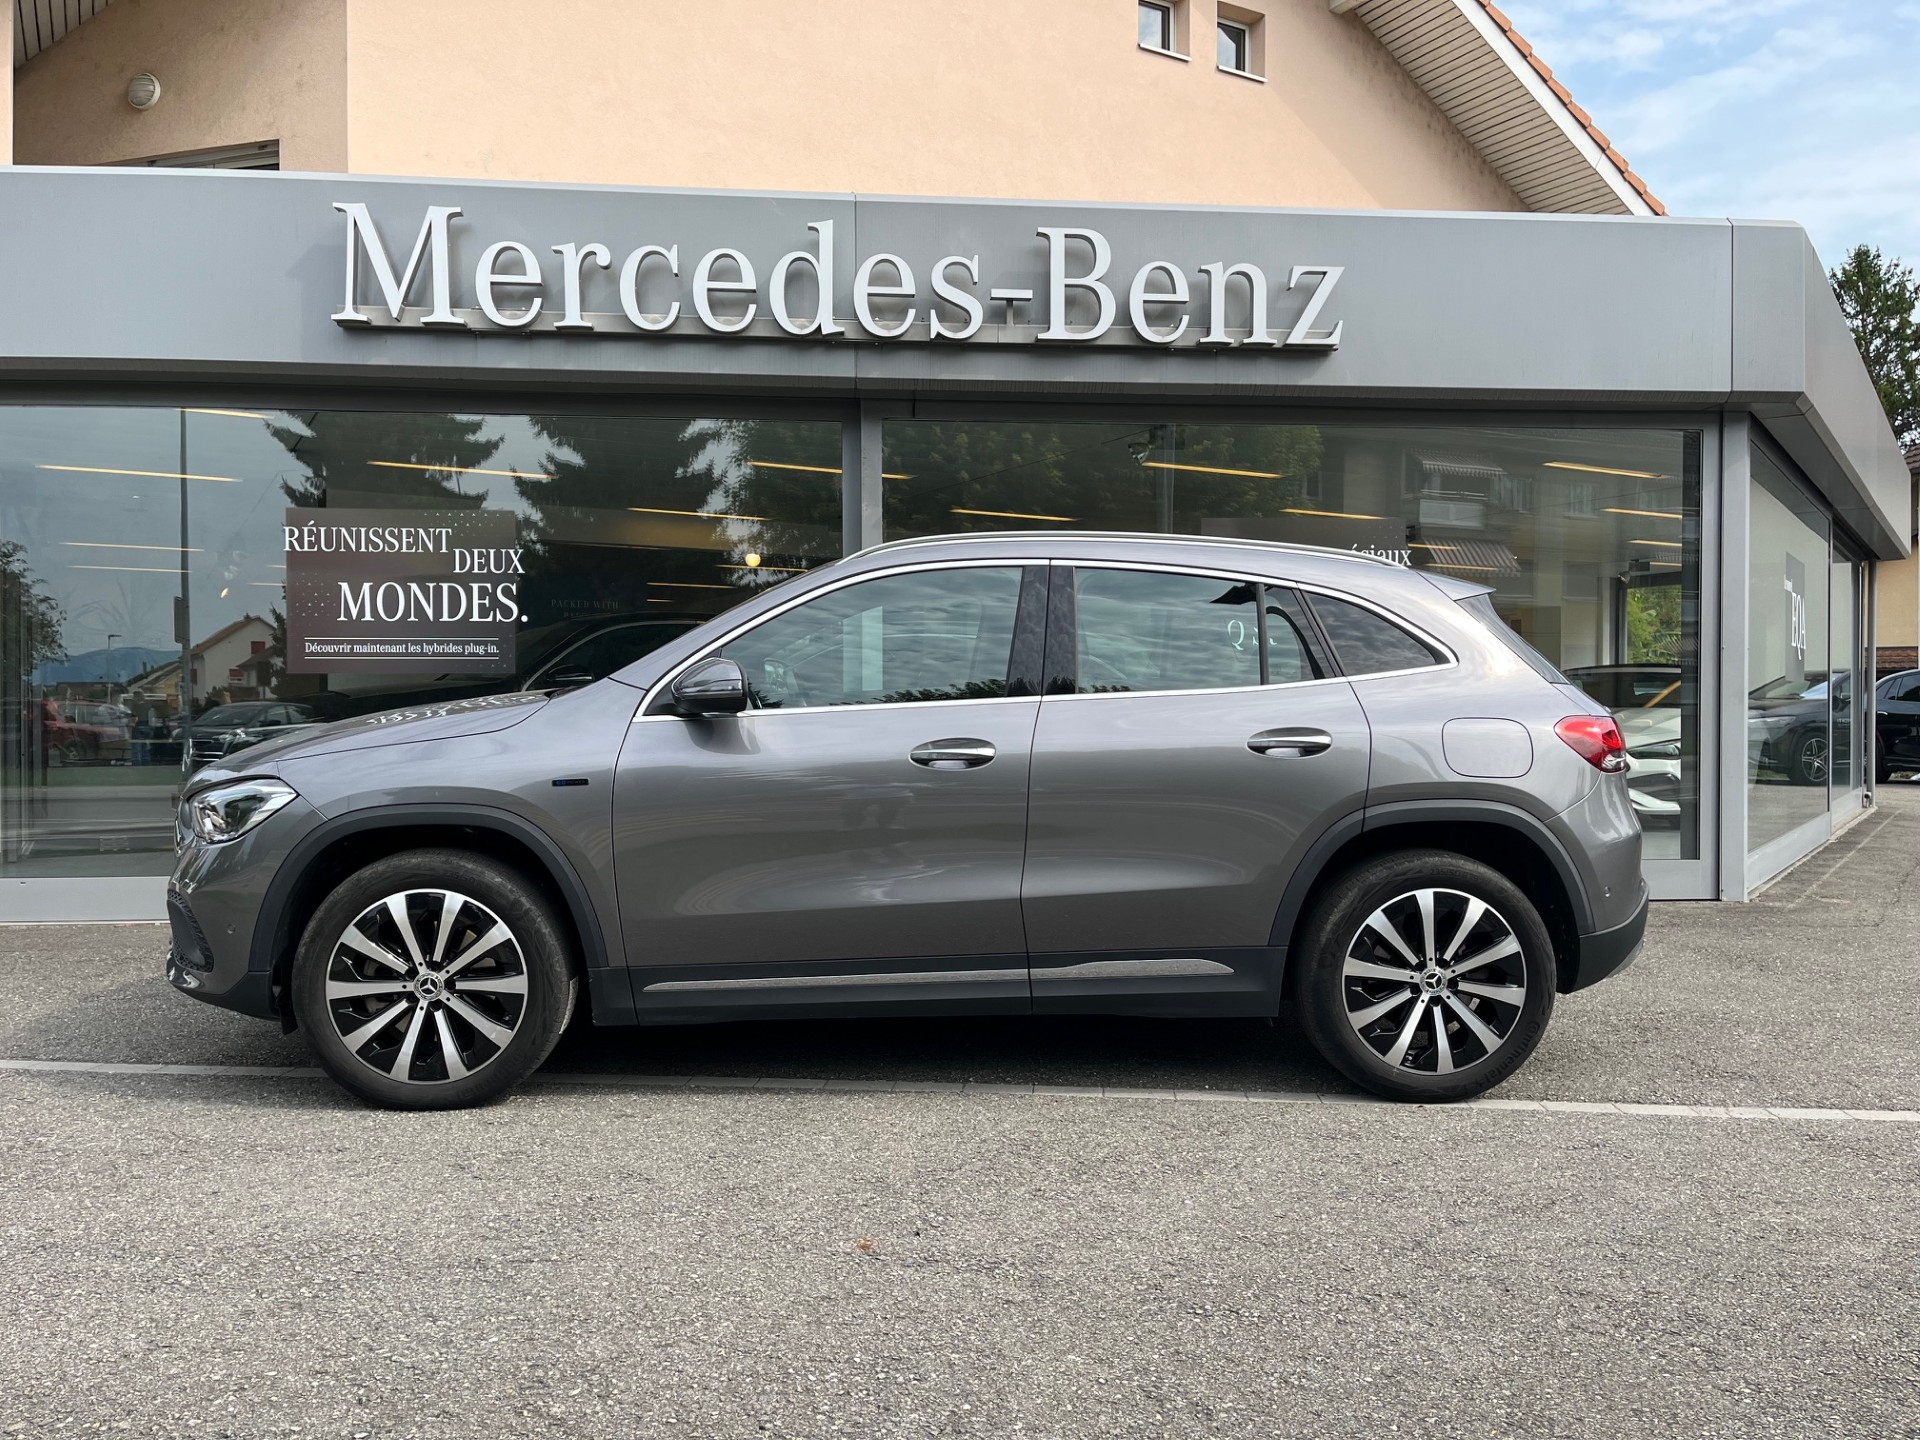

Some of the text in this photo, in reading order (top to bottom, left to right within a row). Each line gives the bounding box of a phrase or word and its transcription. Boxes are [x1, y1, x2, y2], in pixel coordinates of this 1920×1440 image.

[331, 201, 1345, 347] Mercedes-Benz
[283, 520, 452, 553] RÉUNISSENT
[453, 548, 526, 574] DEUX
[337, 581, 529, 623] MONDES.
[305, 642, 500, 655] Découvrir maintenant les hybrides plug-in.
